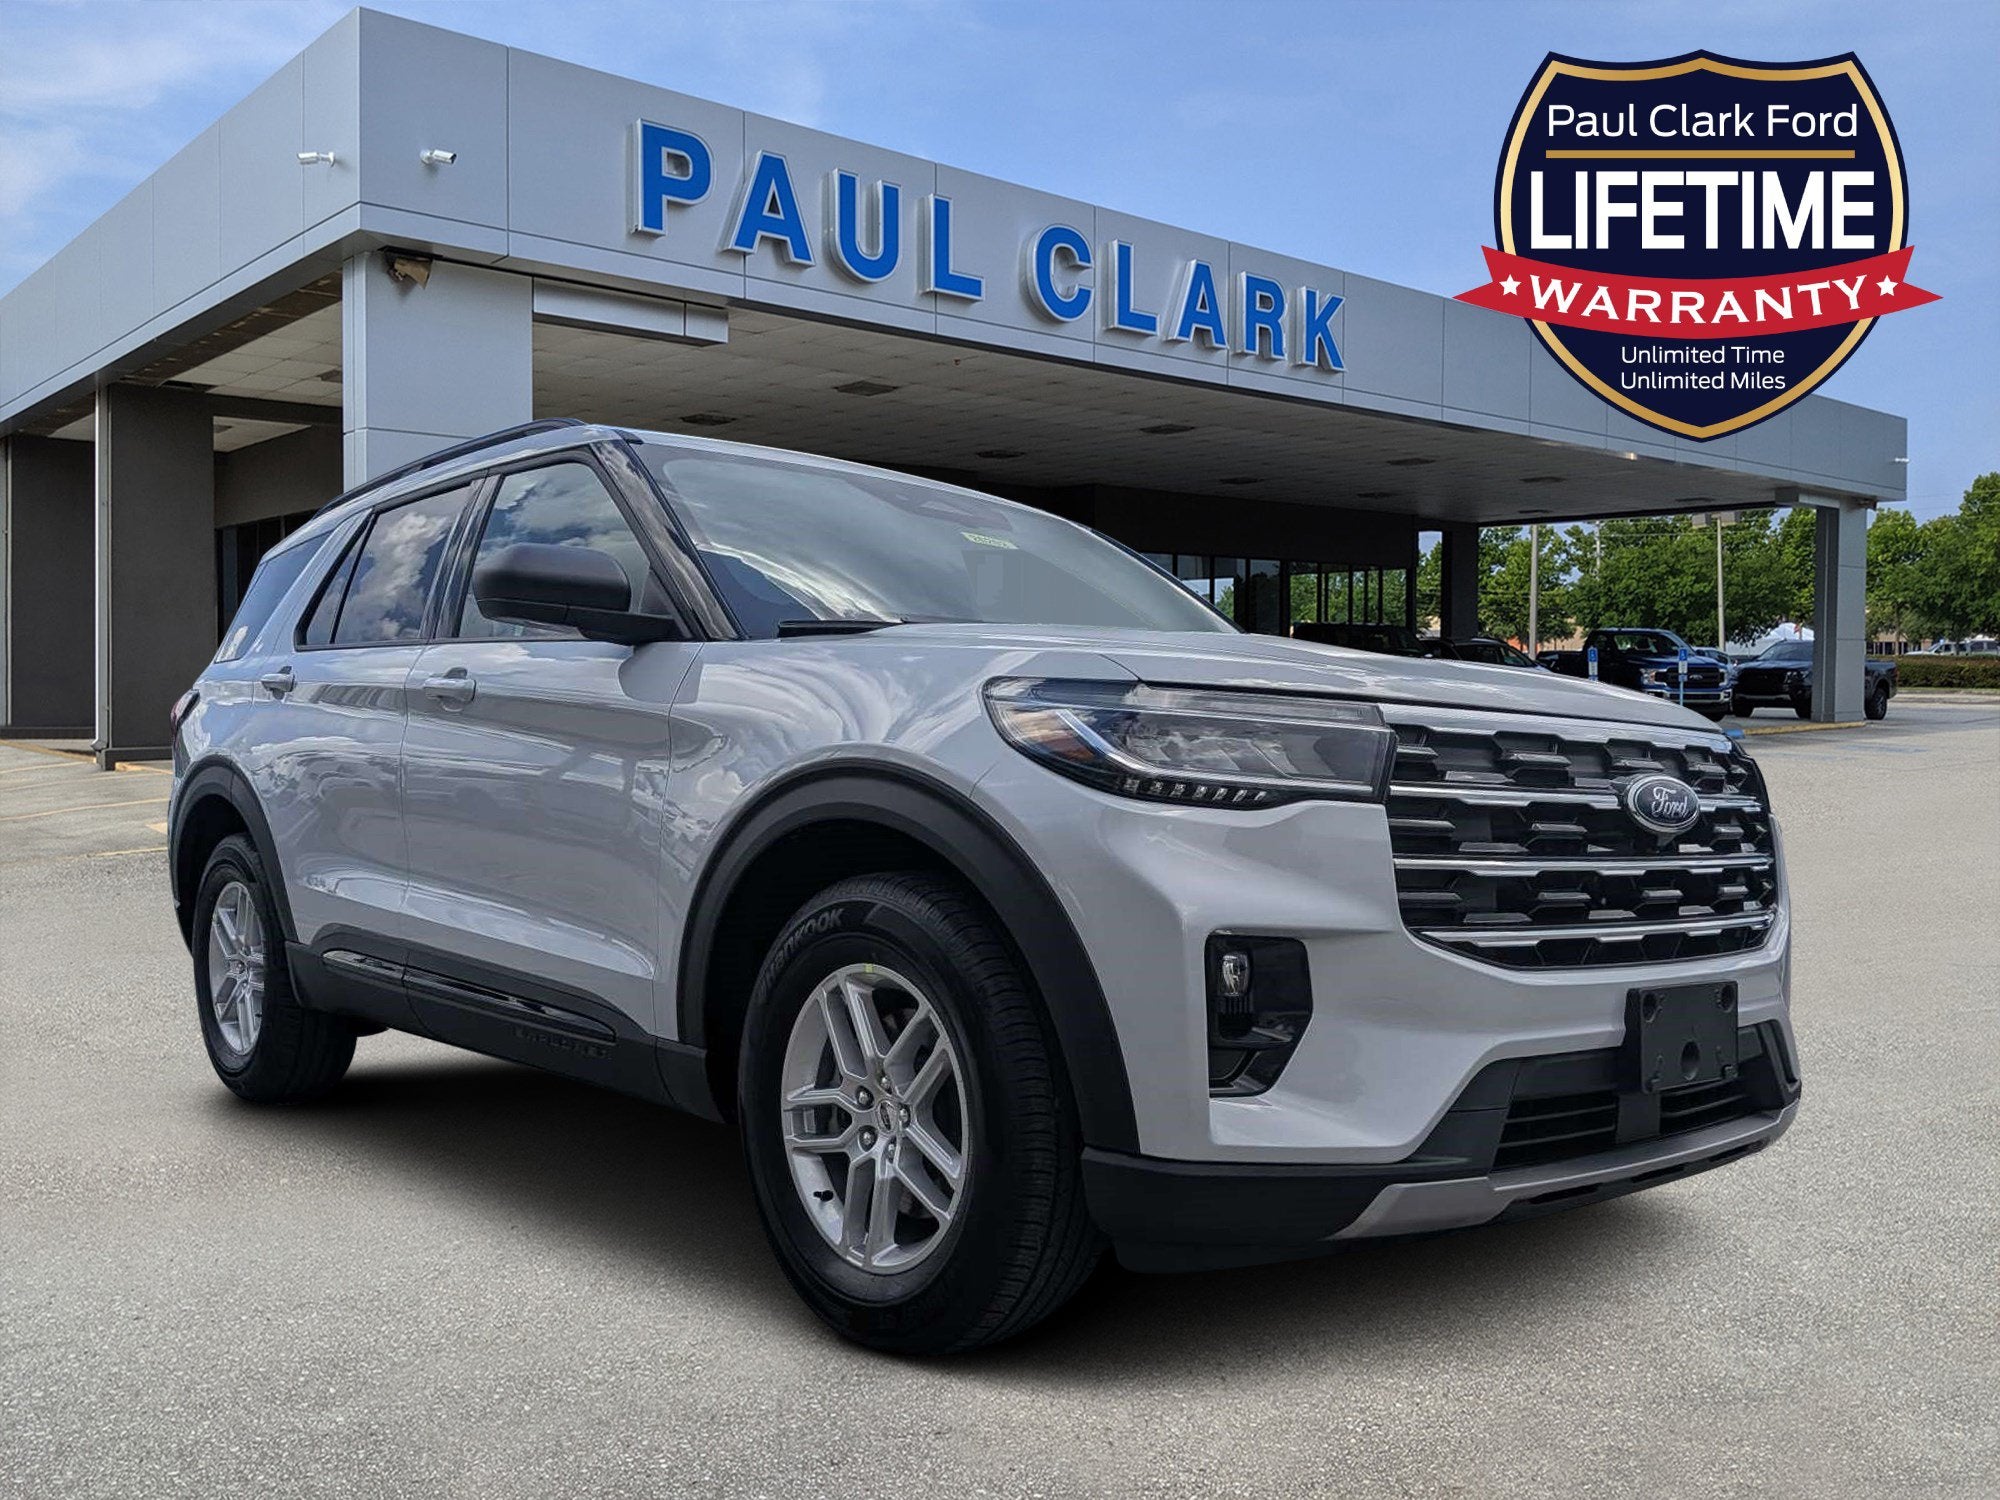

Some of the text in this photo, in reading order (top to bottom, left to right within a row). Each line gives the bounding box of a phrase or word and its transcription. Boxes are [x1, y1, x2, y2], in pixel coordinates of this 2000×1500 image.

[632, 117, 1346, 372] PAUL CLARK
[1651, 786, 1689, 818] Ford
